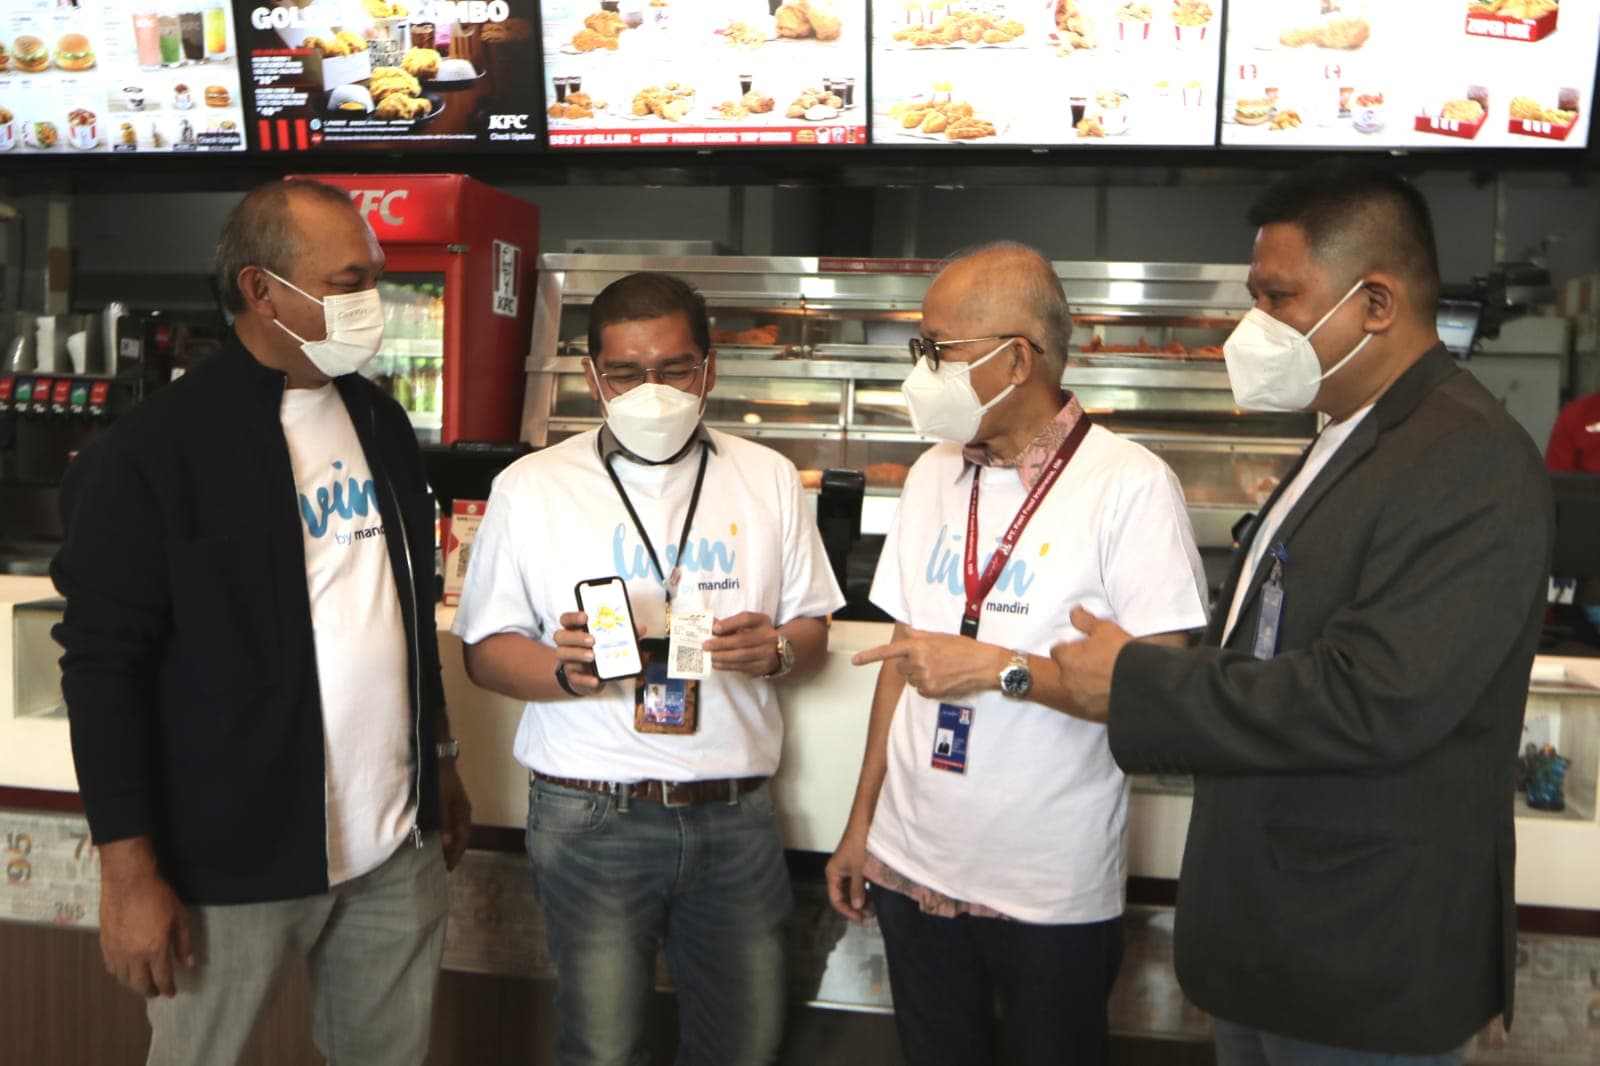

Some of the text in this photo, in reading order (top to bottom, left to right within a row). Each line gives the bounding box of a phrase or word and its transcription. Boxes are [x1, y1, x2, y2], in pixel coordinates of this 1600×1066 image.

[488, 114, 529, 129] KFC
[550, 134, 582, 145] BEST
[698, 577, 741, 592] mandiri
[986, 601, 1029, 615] mandiri
